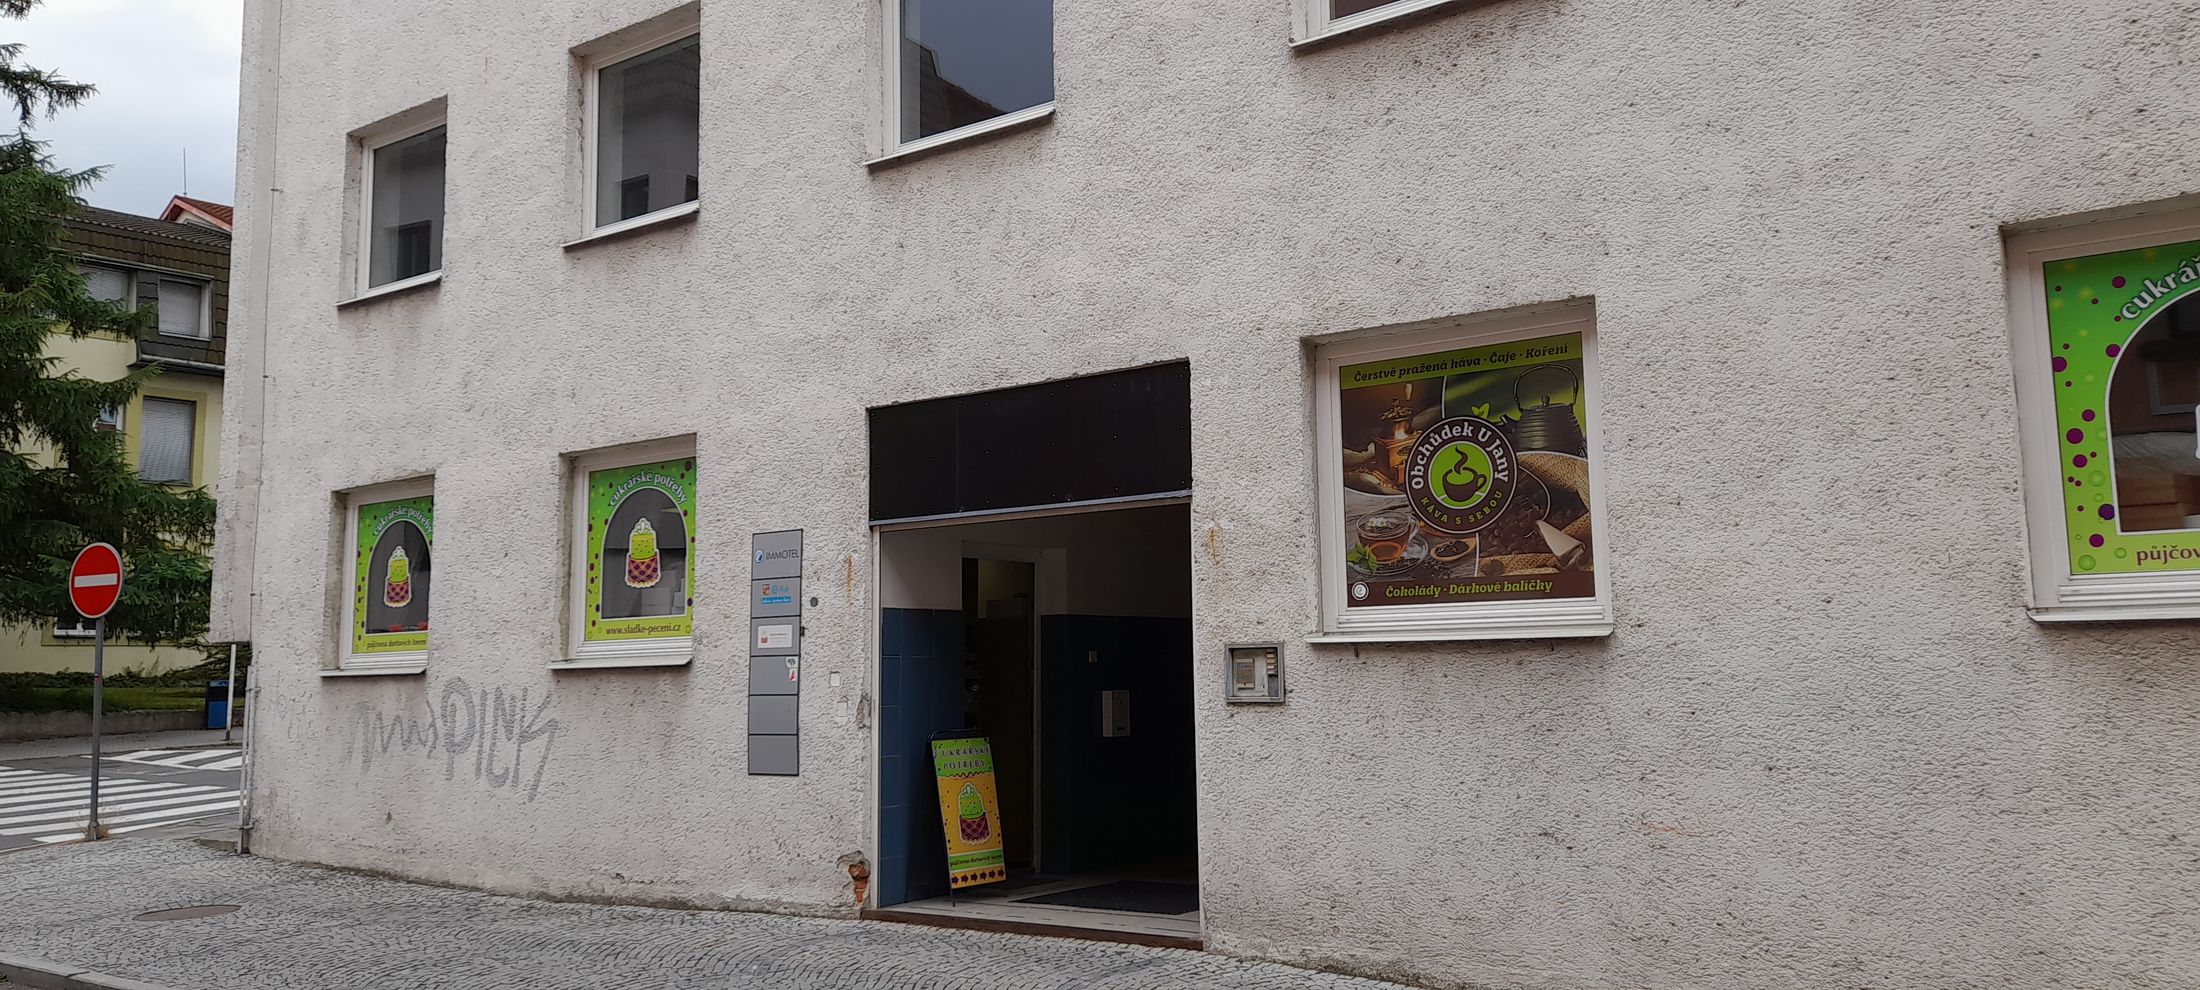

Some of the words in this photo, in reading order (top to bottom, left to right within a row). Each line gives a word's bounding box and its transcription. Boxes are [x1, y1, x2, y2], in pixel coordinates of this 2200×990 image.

[1354, 366, 1397, 382] Čerstvě
[1398, 357, 1448, 380] pražená
[1450, 356, 1481, 370] káva
[1489, 350, 1517, 367] Čaje
[1525, 342, 1568, 360] Koření
[1408, 421, 1473, 490] Obchůdek
[1478, 427, 1492, 443] U
[1486, 439, 1509, 483] Jany
[1455, 516, 1463, 525] S
[1468, 488, 1504, 524] SEBOU
[765, 549, 800, 560] IMMOTEL
[1385, 585, 1442, 598] Čokolády
[1448, 581, 1502, 595] Dárkové
[1503, 578, 1553, 594] balíčky
